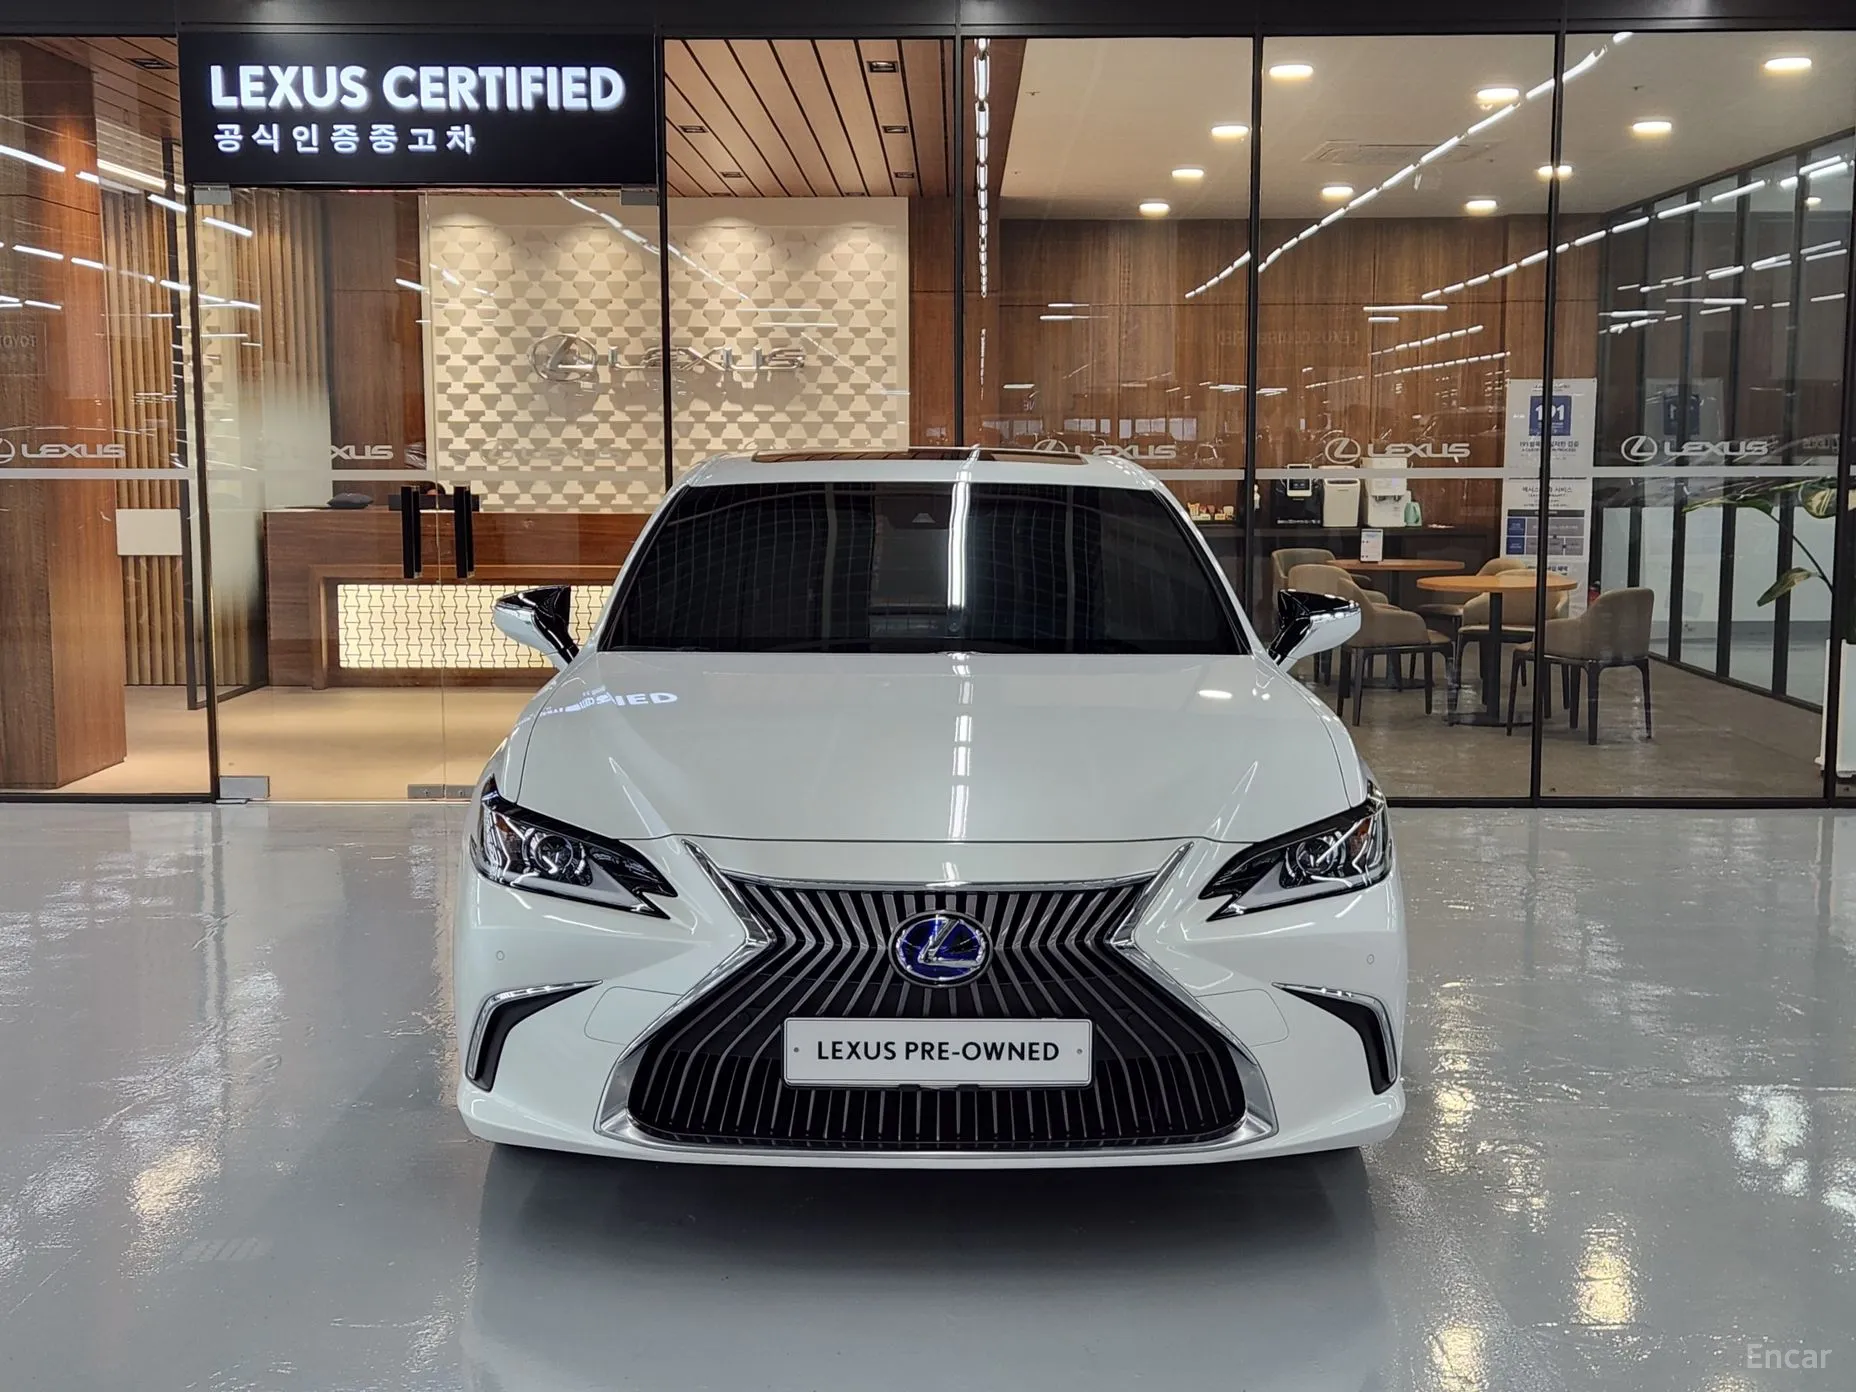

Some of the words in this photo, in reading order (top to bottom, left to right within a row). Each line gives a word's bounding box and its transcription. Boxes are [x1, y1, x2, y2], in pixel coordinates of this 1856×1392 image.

[210, 65, 368, 109] LEXUS
[382, 65, 626, 110] CERTIFIED
[213, 123, 476, 154] 공식인증중고차
[608, 346, 805, 371] LEXUS
[21, 444, 126, 458] LEXUS
[330, 444, 394, 460] XUS
[1367, 443, 1471, 458] LEXUS
[1664, 441, 1769, 456] LEXUS
[817, 1041, 897, 1060] LEXUS
[904, 1041, 1060, 1061] PRE-OWNED
